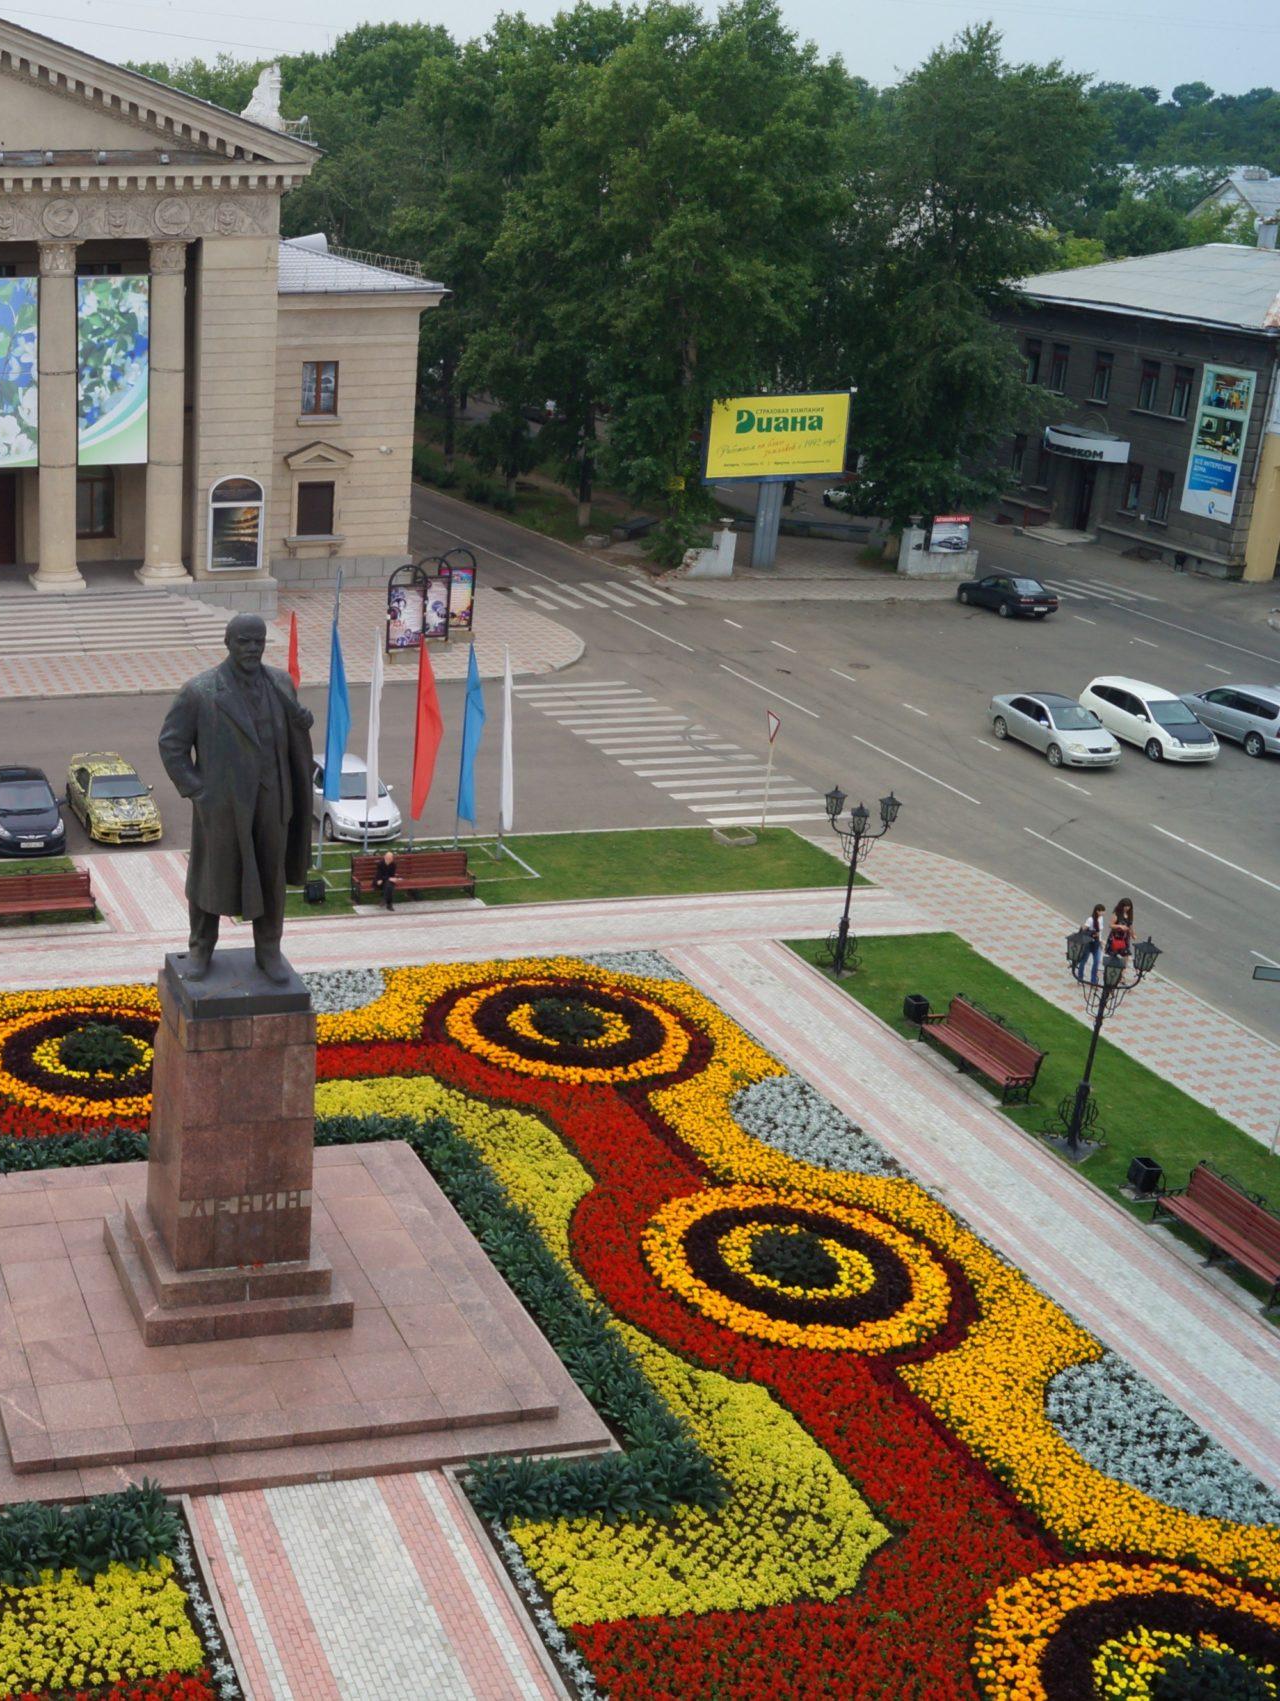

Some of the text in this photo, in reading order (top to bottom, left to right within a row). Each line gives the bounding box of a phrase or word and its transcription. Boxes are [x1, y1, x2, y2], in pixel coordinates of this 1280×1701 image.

[736, 409, 824, 434] Диана
[755, 407, 789, 415] СТРАХОВАЯ
[190, 1189, 302, 1218] ЛЕНИН
